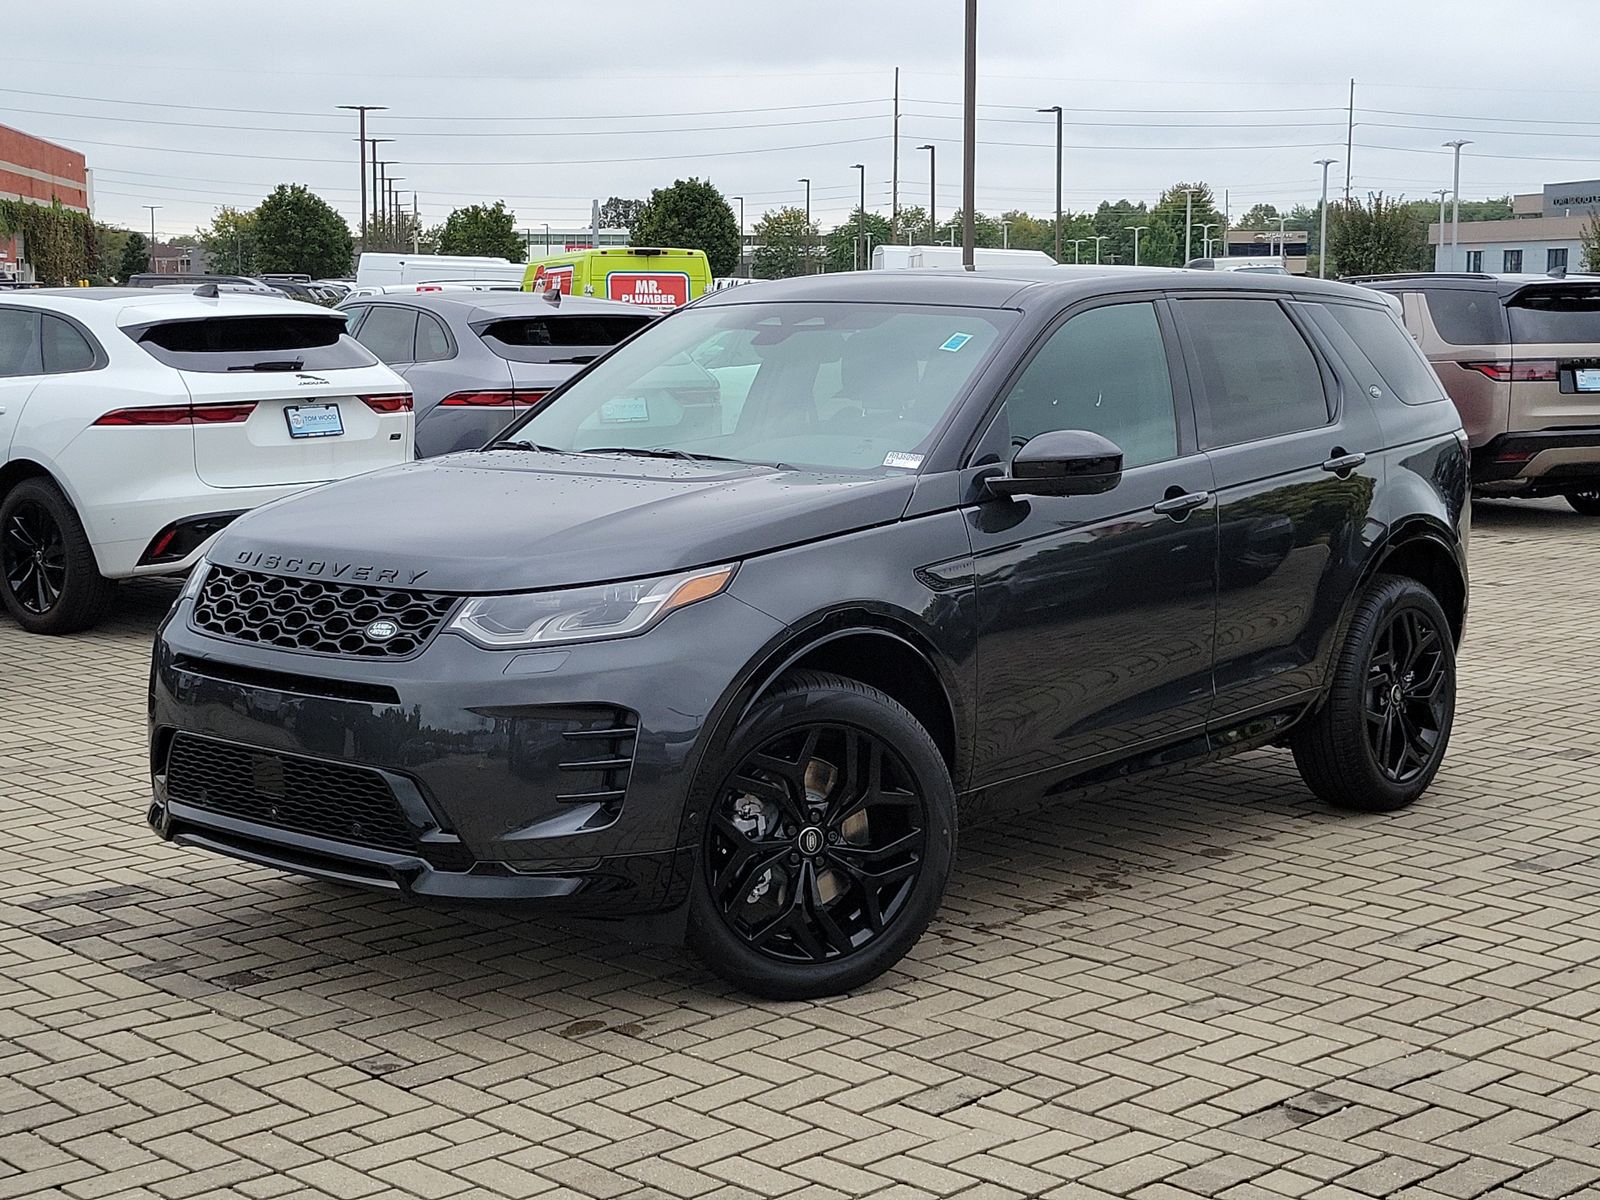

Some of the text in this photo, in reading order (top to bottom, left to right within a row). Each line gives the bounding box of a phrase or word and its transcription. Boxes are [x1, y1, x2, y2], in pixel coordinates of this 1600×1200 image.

[635, 279, 662, 294] MR.
[621, 294, 676, 304] PLUMBER
[318, 413, 337, 421] WOOD
[235, 551, 429, 585] DISCOVERY
